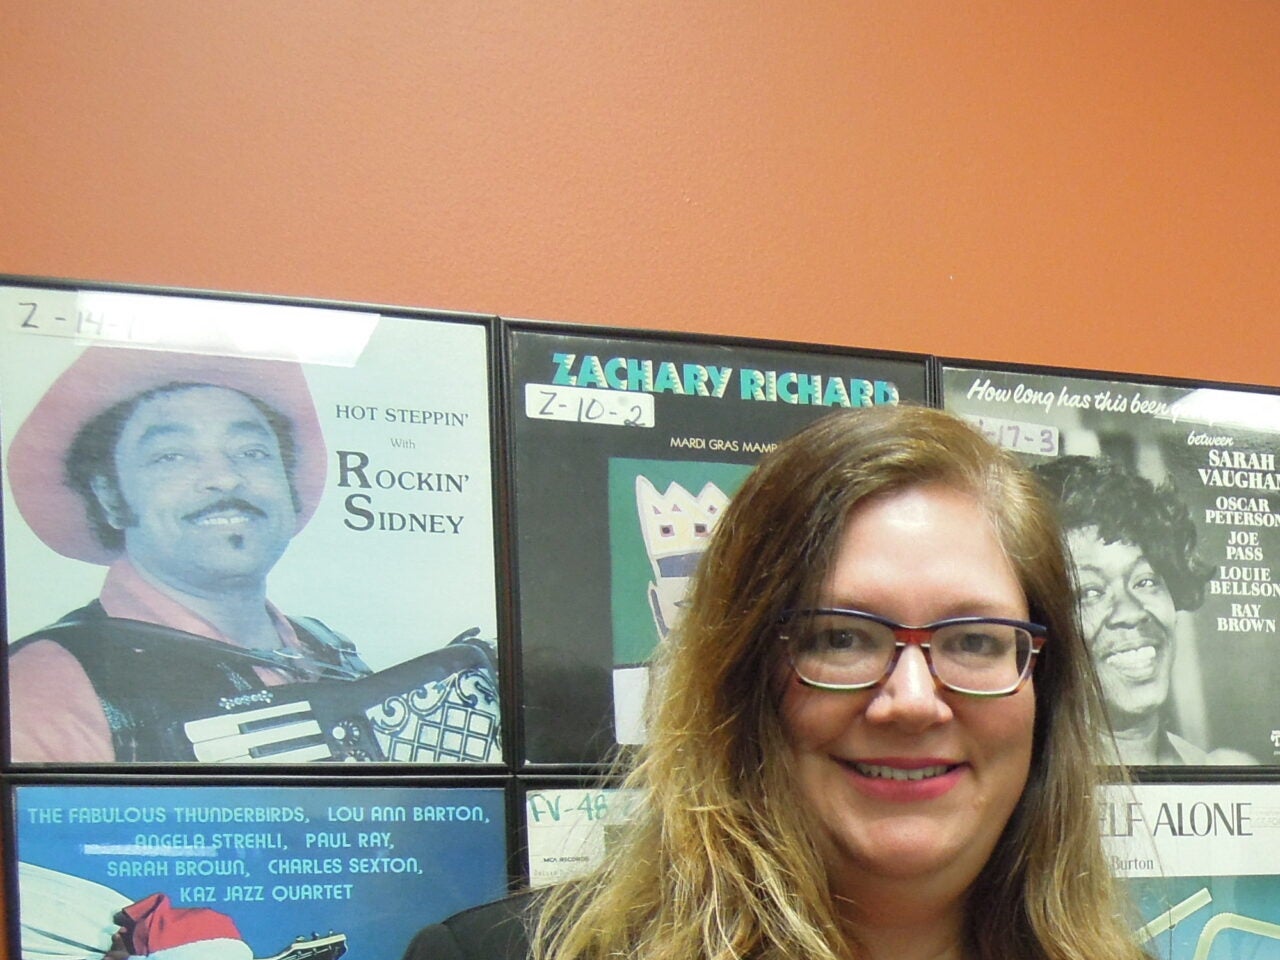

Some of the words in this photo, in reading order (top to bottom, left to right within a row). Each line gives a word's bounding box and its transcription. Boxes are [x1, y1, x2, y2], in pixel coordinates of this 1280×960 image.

[552, 353, 733, 399] ZACHARY
[740, 368, 900, 408] RICHARD
[967, 378, 1012, 401] How
[1013, 383, 1054, 413] long
[1057, 386, 1090, 408] has
[1095, 391, 1127, 412] this
[1130, 393, 1169, 415] been
[336, 404, 378, 421] HOT
[385, 408, 469, 427] STEPPIN'
[390, 438, 416, 449] With
[670, 437, 706, 450] MARDI
[709, 439, 739, 451] GRAS
[1188, 430, 1234, 446] between
[1209, 449, 1275, 471] SARAH
[1216, 496, 1270, 512] OSCAR
[344, 493, 465, 534] SIDNEY
[1228, 531, 1259, 545] JOE
[1226, 546, 1263, 561] PASS
[1220, 566, 1271, 581] LOUIE
[1231, 603, 1261, 618] RAY
[1217, 617, 1276, 633] BROWN
[28, 808, 63, 824] THE
[69, 807, 166, 824] FABULOUS
[174, 806, 310, 824] THUNDERBIRDS,
[328, 806, 364, 822] LOU
[371, 806, 406, 822] ANN
[413, 806, 490, 824] BARTON,
[1153, 802, 1253, 837] ALONE
[135, 833, 205, 849] ANGELA
[212, 833, 288, 850] STREHLI,
[306, 832, 351, 848] PAUL
[358, 832, 395, 849] RAY,
[107, 860, 168, 877] SARAH
[175, 859, 250, 878] BROWN,
[268, 858, 342, 875] CHARLES
[349, 858, 423, 875] SEXTON,
[180, 886, 216, 902] KAZ
[223, 886, 265, 901] JAZZ
[272, 884, 353, 902] QUARTET
